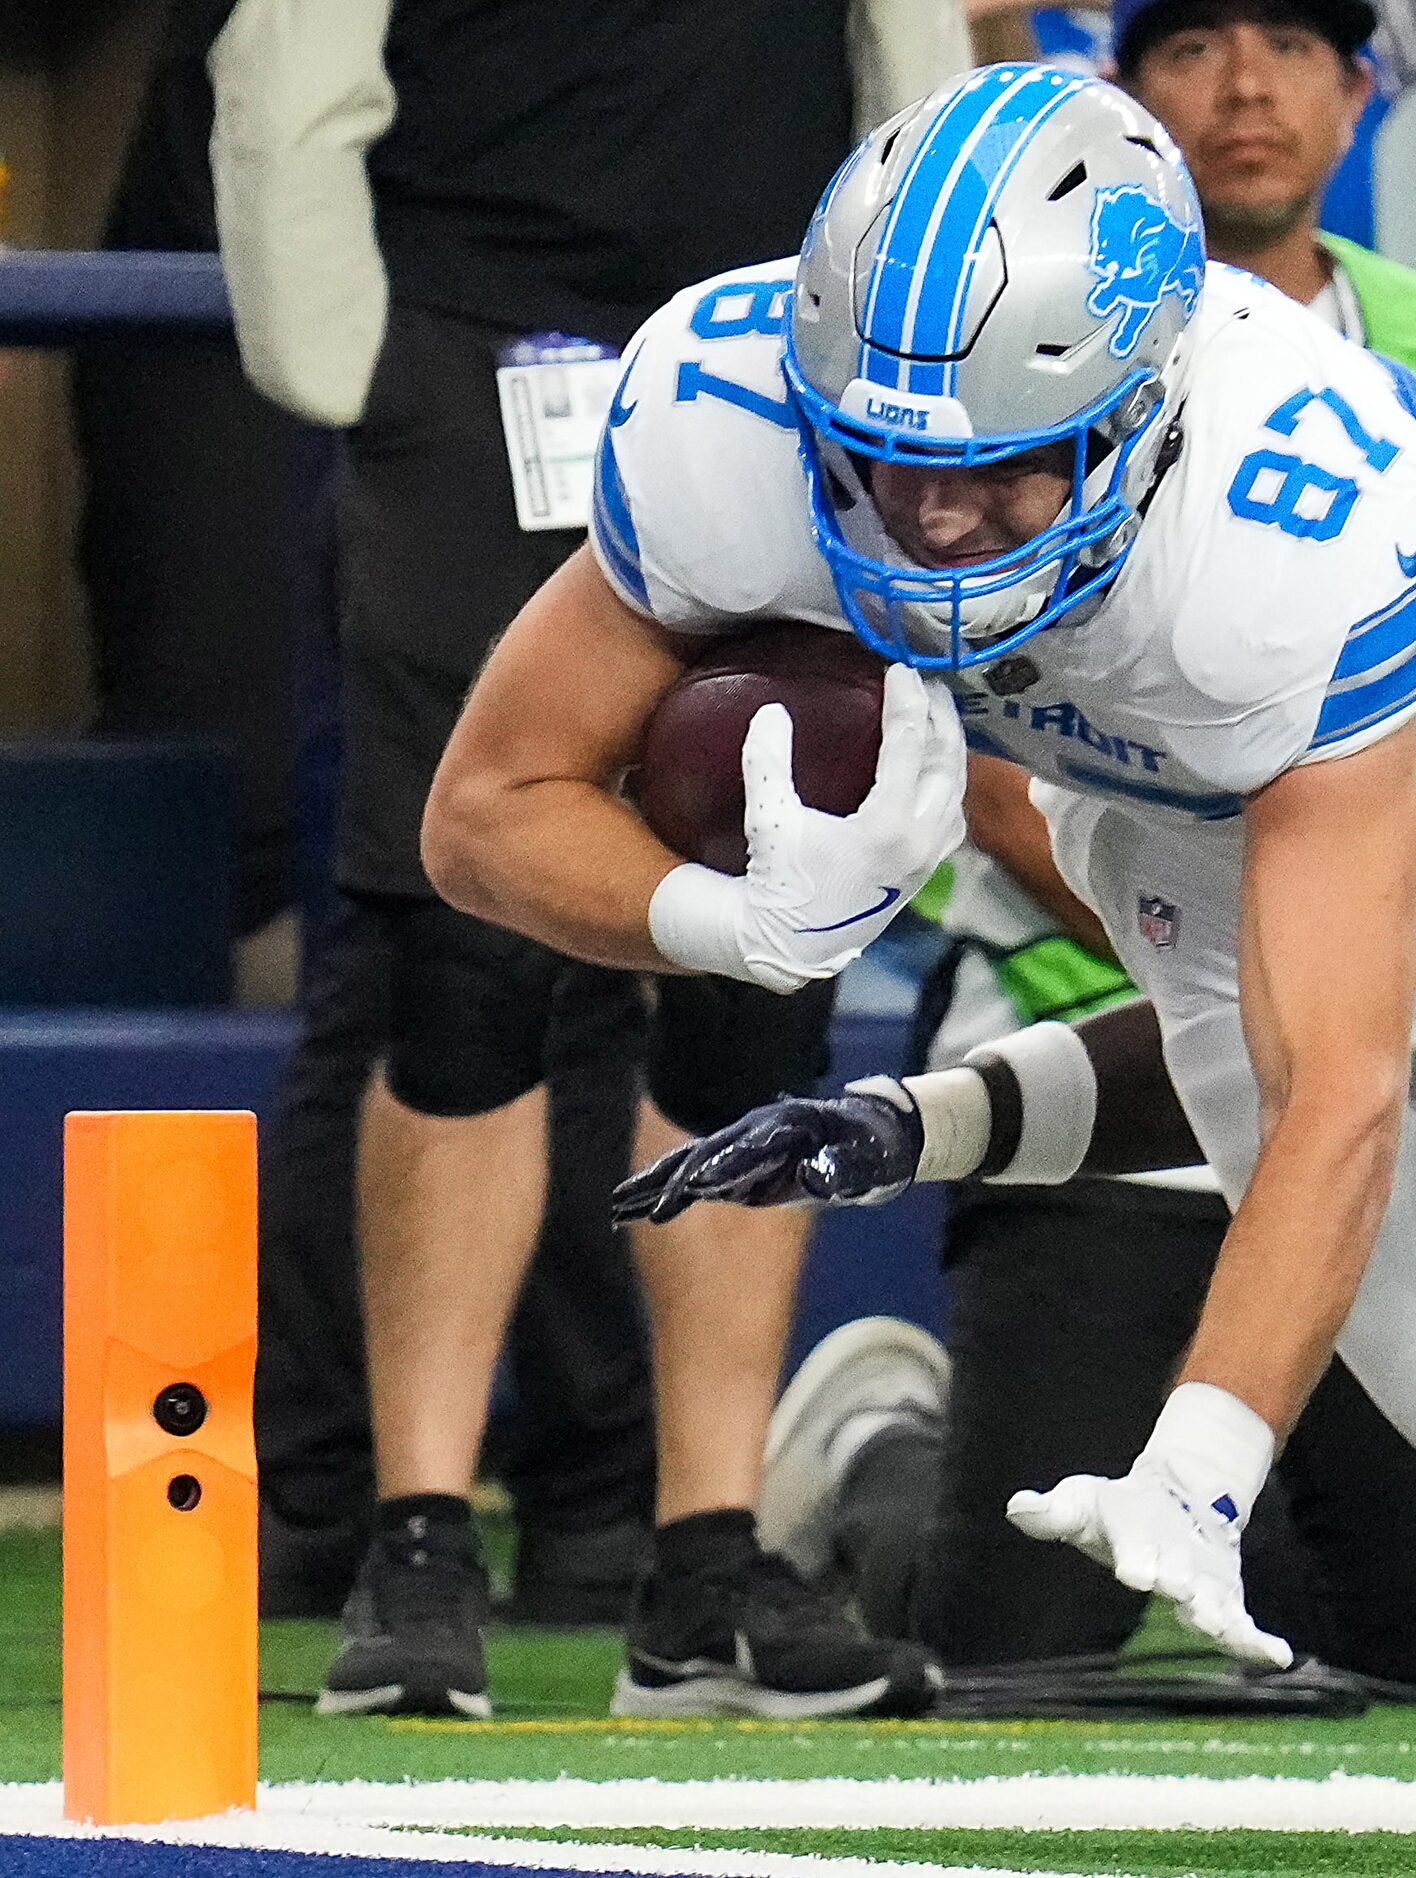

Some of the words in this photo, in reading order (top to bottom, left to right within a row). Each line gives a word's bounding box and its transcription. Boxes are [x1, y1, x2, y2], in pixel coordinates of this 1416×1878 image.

[867, 397, 930, 431] LIONS
[1226, 386, 1400, 542] 87
[953, 691, 1167, 773] ETROIT
